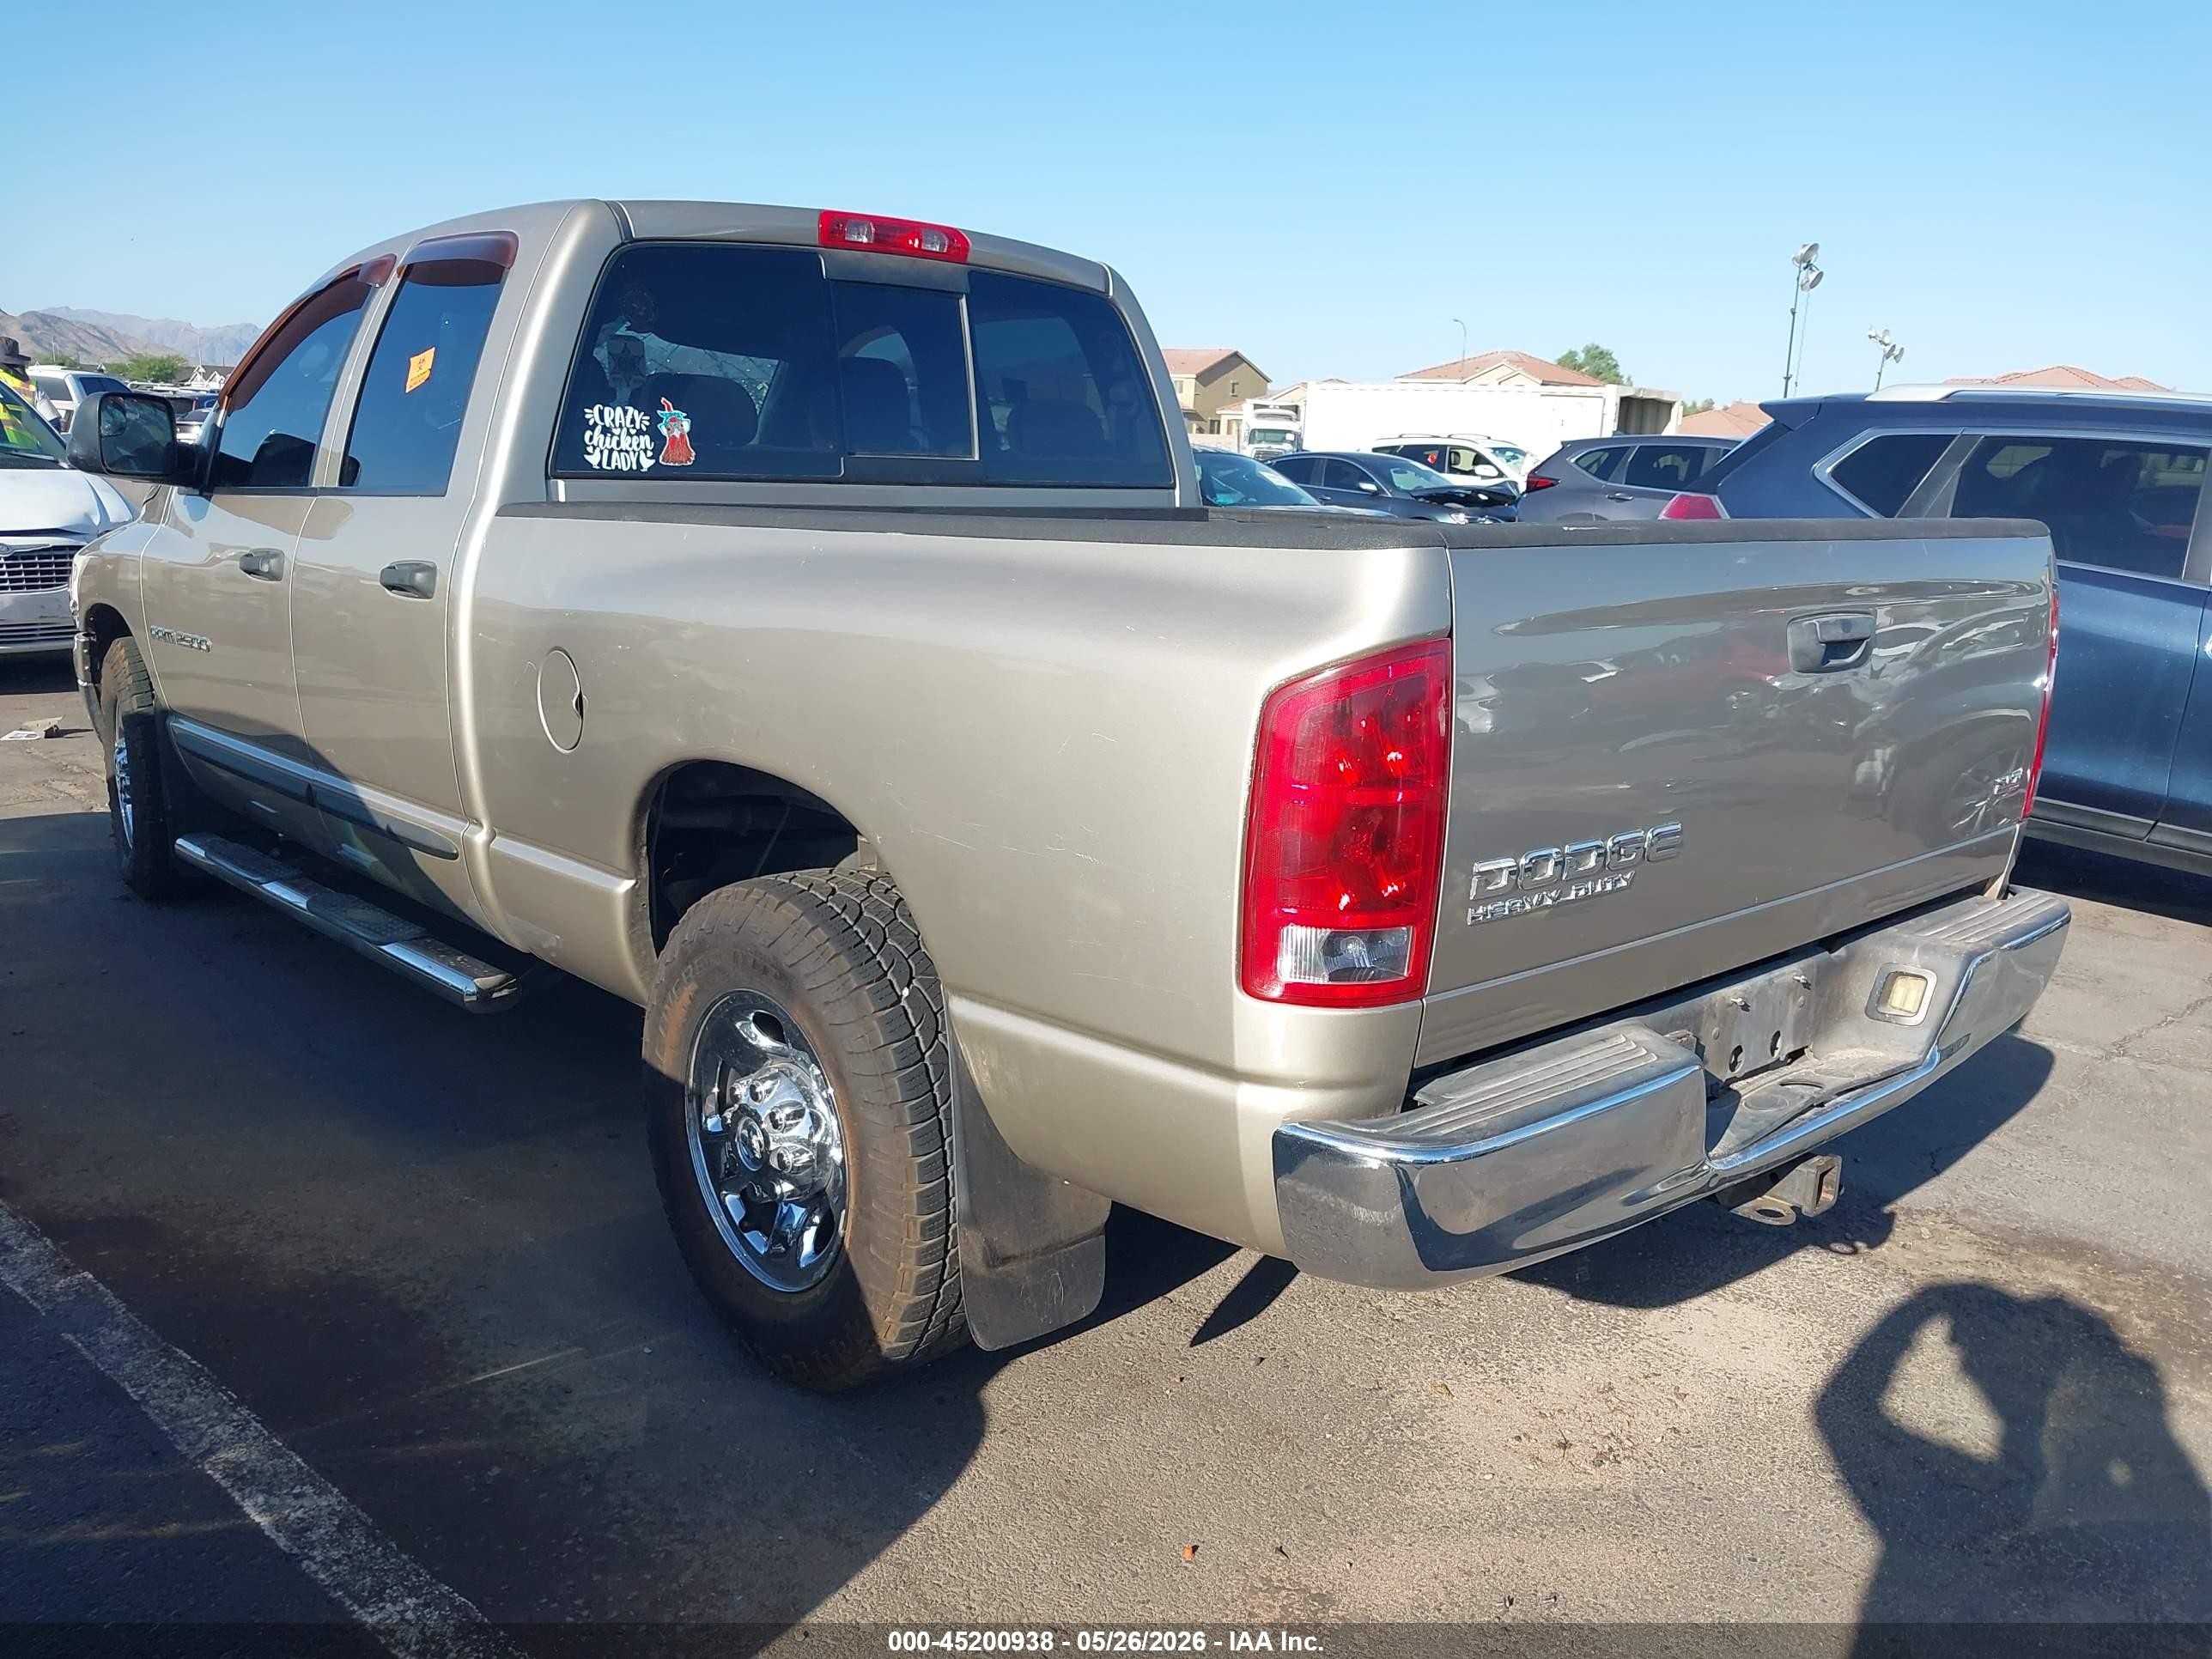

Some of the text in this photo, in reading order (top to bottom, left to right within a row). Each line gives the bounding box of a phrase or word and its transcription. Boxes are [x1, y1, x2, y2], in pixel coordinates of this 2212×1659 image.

[592, 404, 644, 429] CRAZY
[584, 425, 654, 452] chicken
[602, 448, 639, 471] LADY
[1469, 821, 1683, 901] DODGE
[1467, 870, 1637, 927] HEAVY DUTY
